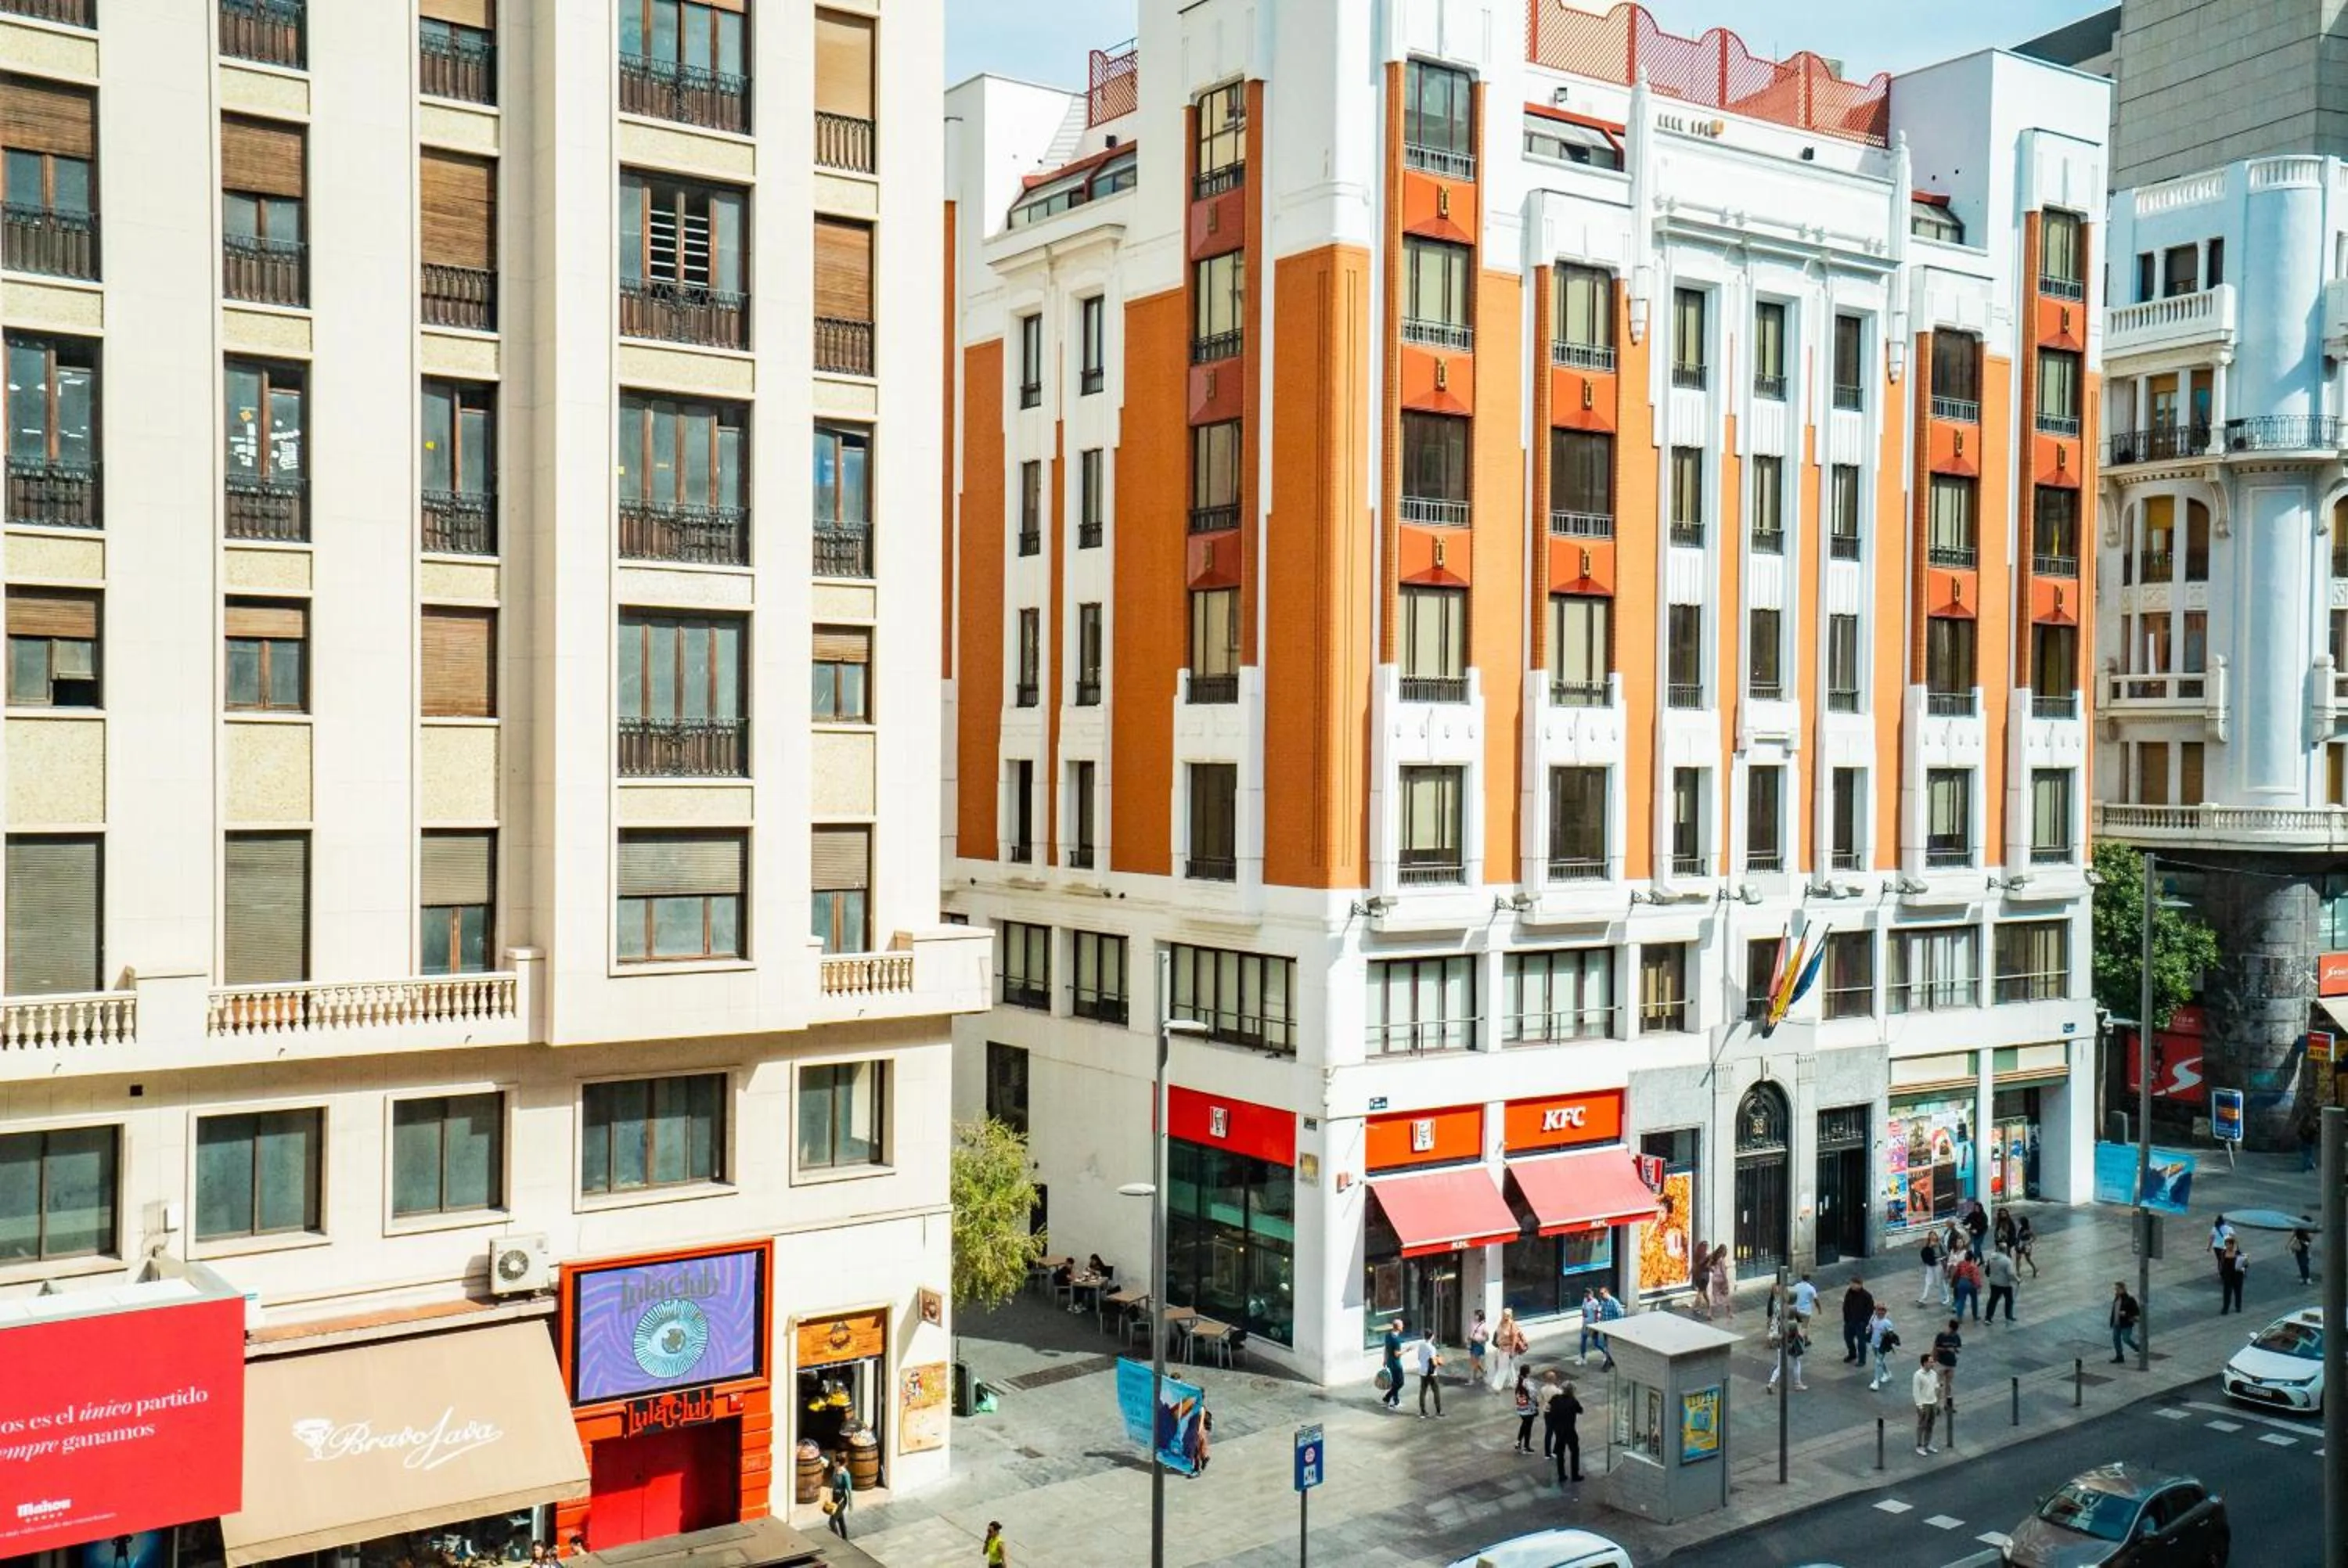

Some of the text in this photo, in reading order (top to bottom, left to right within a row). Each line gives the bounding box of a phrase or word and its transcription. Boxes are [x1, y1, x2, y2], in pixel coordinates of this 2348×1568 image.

[1543, 1106, 1586, 1131] KFC
[29, 1414, 52, 1430] es
[56, 1404, 74, 1426] el
[78, 1400, 132, 1422] único
[136, 1386, 208, 1417] partido
[62, 1423, 156, 1455] ganamos
[16, 1498, 72, 1518] Mahou
